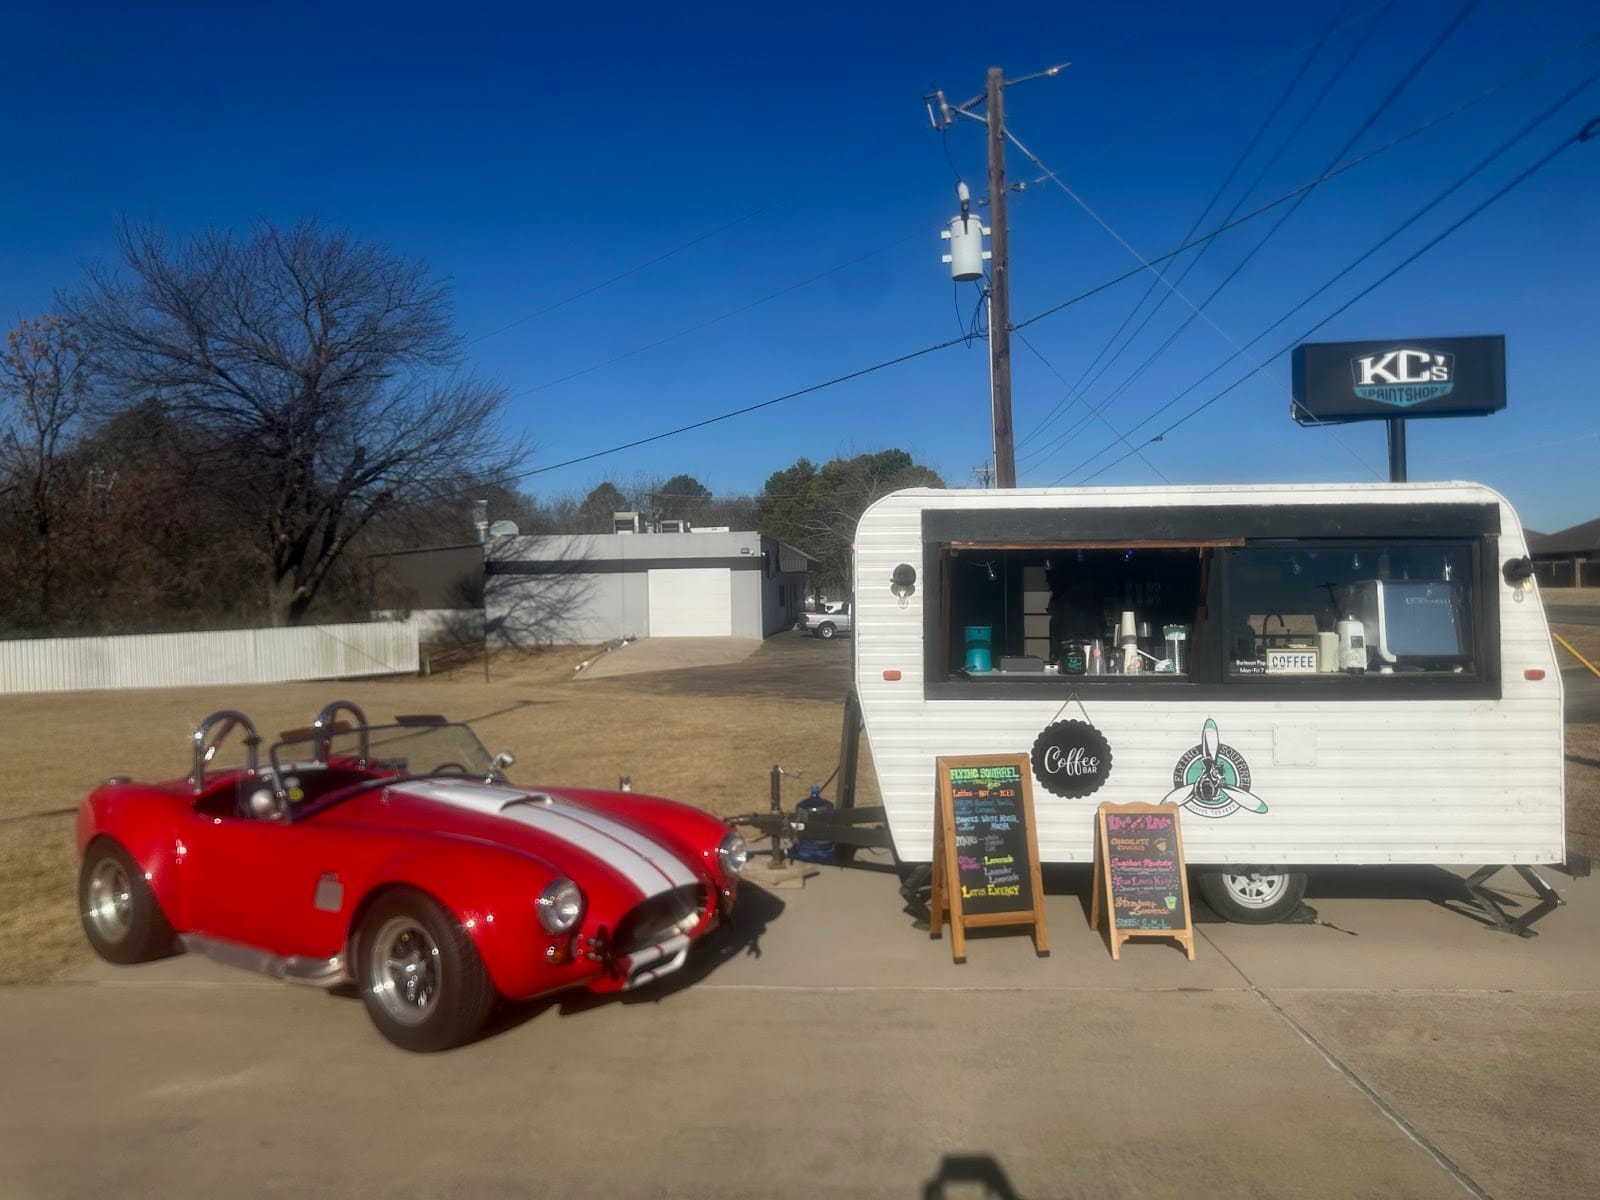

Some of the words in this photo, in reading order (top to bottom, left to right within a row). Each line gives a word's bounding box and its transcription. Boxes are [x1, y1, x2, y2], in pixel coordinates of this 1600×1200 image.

[1358, 349, 1449, 385] KC's
[1367, 386, 1439, 403] PAINTSHOP
[1271, 655, 1315, 669] COFFEE
[1044, 745, 1101, 777] Coffee
[1082, 766, 1098, 775] BAR
[1174, 747, 1201, 783] FLYING
[1219, 745, 1251, 788] SQUIRREL
